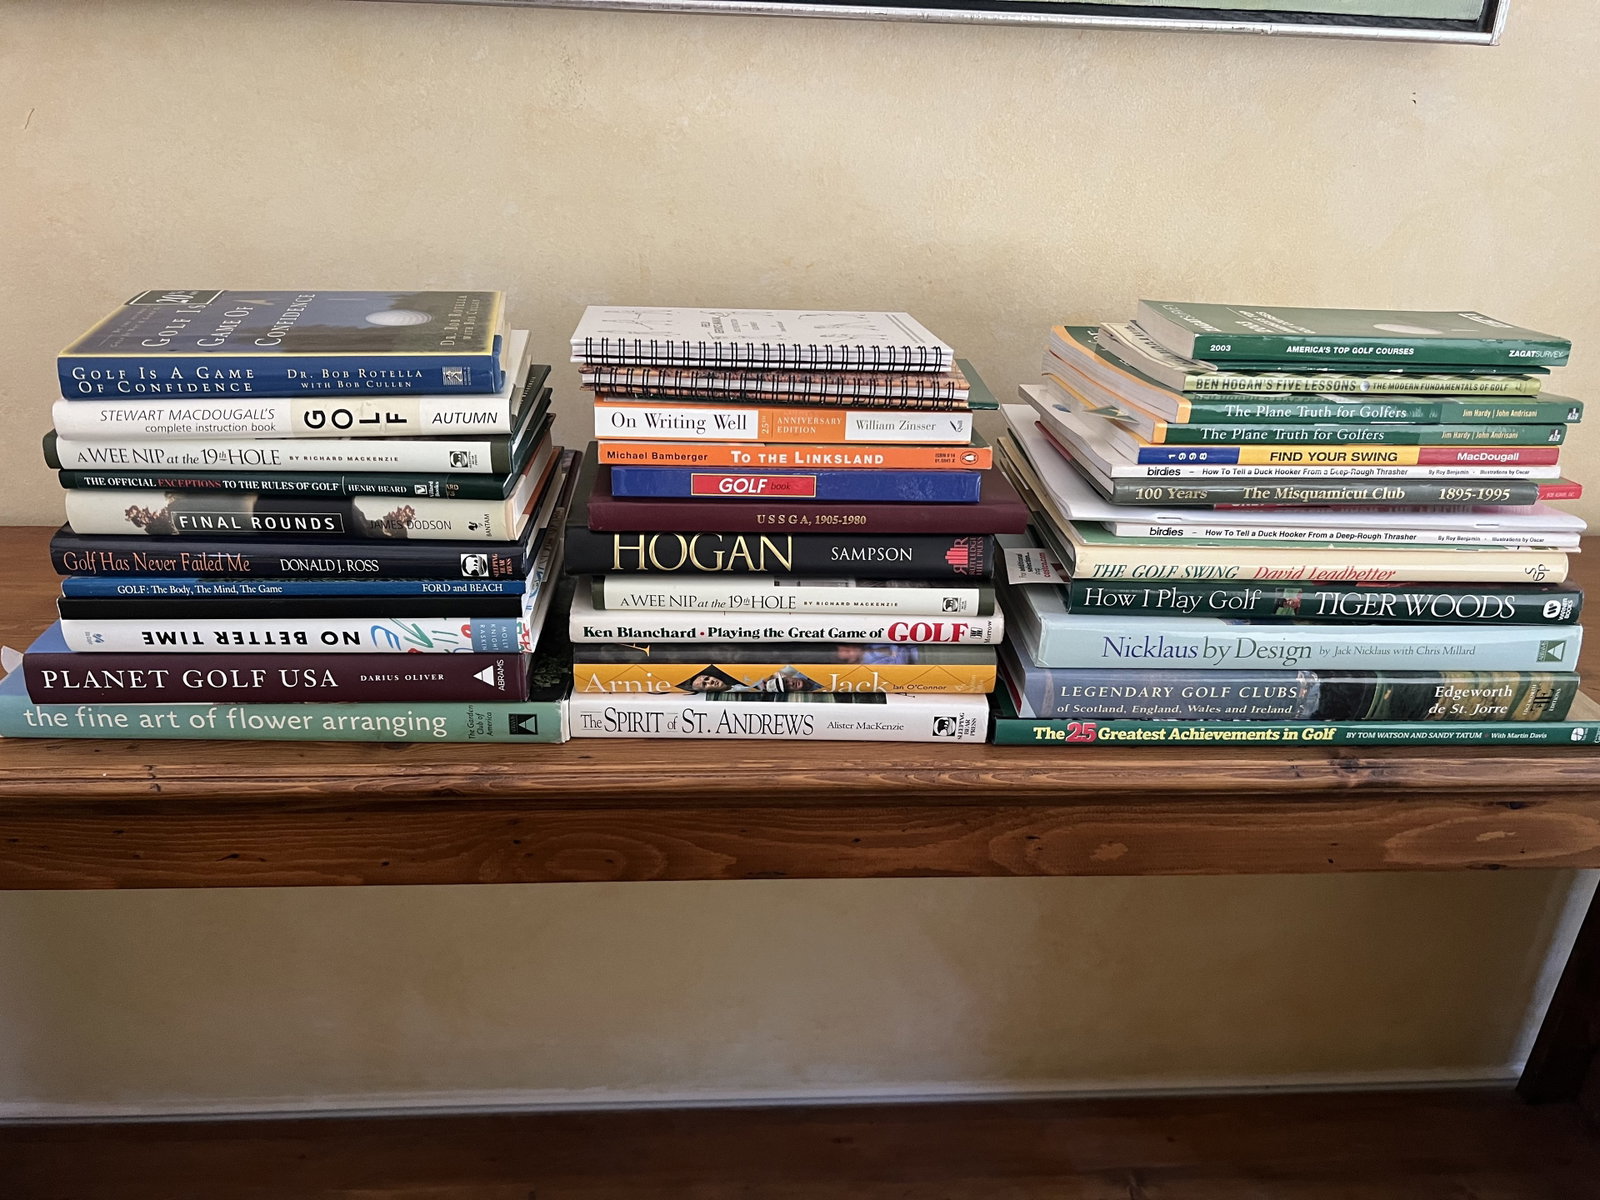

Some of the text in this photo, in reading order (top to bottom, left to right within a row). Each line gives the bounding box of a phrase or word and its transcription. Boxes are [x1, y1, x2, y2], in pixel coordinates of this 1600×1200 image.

[1210, 344, 1232, 352] 2003
[1286, 346, 1331, 354] AMERICA'S
[1352, 347, 1373, 355] GOLF
[1376, 347, 1414, 356] COURSES
[100, 409, 164, 422] STEWART
[304, 408, 408, 430] GOLF
[432, 412, 498, 425] AUTUMN
[611, 411, 747, 434] On Writing Well
[145, 421, 276, 434] complete instruction book
[856, 419, 936, 431] William Zinsser
[607, 451, 708, 461] Michael Bamberger
[1270, 452, 1398, 462] FIND YOUR SWING
[1457, 452, 1519, 463] MacDougall
[84, 476, 339, 492] THE OFFICIAL EXCEPTIONS TO THE RULES OF GOLF
[719, 478, 791, 493] GOLF book
[1135, 488, 1511, 502] 100 Years The Misquamicut Club 1895-1995
[179, 515, 336, 530] FINAL ROUNDS
[815, 515, 867, 525] 1905-1980
[1150, 527, 1183, 536] birdies
[1205, 529, 1221, 537] How
[1222, 529, 1234, 537] To
[1236, 529, 1250, 537] Tell
[1278, 530, 1306, 538] Hooker
[1308, 531, 1327, 539] From
[1336, 532, 1381, 541] Deep-Rough
[611, 533, 792, 572] HOGAN
[831, 547, 912, 561] SAMPSON
[62, 551, 251, 574] Golf Has Never Failed Me
[280, 559, 379, 573] DONALD J. ROSS
[1093, 564, 1397, 580] THE GOLF SWING David Leadbetter
[1084, 587, 1261, 613] How I Play Golf
[1315, 592, 1516, 618] TIGER WOODS
[142, 631, 360, 645] NO BETTER TIME
[583, 622, 969, 642] Ken Blanchard Playing the Great Game of GOLF
[1102, 636, 1312, 666] Nicklaus by Design
[41, 669, 338, 689] PLANET GOLF USA
[360, 673, 444, 682] DARIUS OLIVER
[496, 659, 505, 691] ABRAMS
[584, 672, 671, 692] Arnie
[823, 672, 890, 692] Jack
[1061, 686, 1297, 699] LEGENDARY GOLF CLUBS
[1057, 704, 1293, 715] of Scotland, England, Wales and Ireland
[23, 706, 447, 737] the fine art of flower arranging
[581, 714, 602, 728] The
[604, 707, 664, 733] SPIRIT
[667, 717, 678, 730] of
[716, 709, 814, 736] ANDREWS
[827, 721, 904, 731] Alister MacKenzie
[1033, 722, 1336, 743] The 25 Greatest Achievements in Golf
